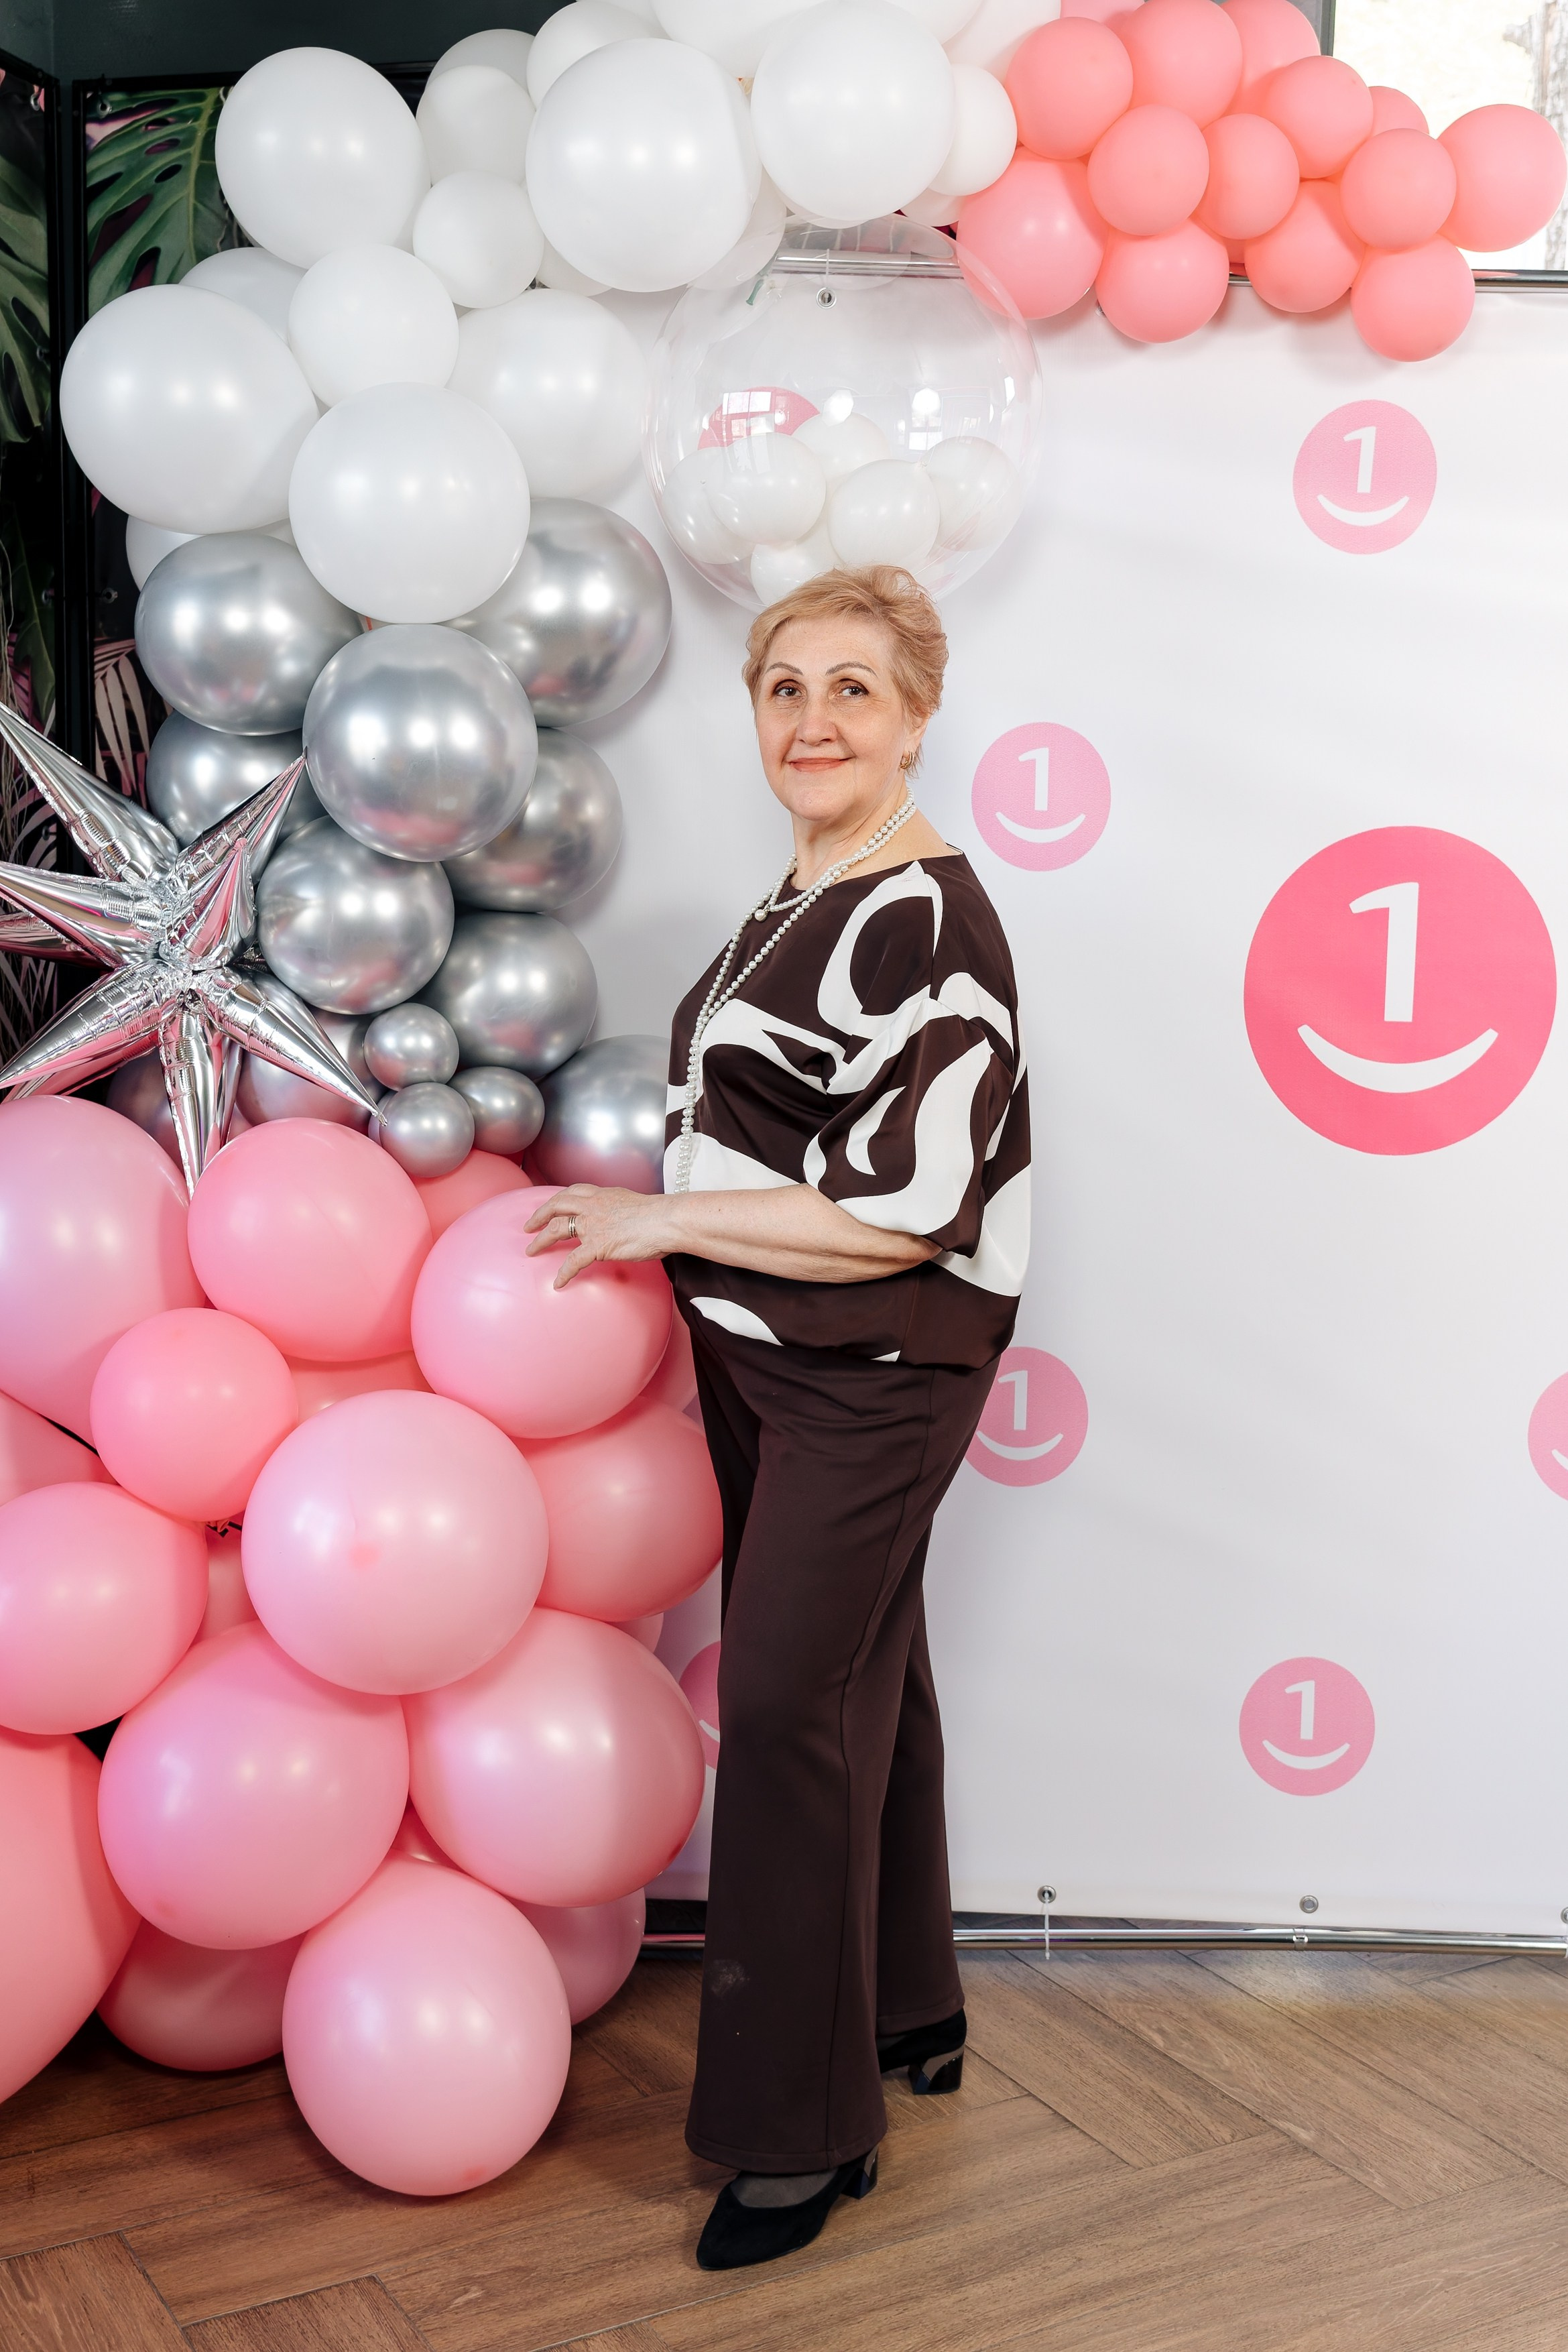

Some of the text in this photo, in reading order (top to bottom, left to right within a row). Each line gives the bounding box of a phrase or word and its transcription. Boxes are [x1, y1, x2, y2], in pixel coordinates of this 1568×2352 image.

[1343, 426, 1376, 493] 1
[1018, 748, 1049, 811] 1
[1349, 882, 1419, 1022] 1
[998, 1370, 1028, 1430] 1
[1284, 1680, 1315, 1740] 1
